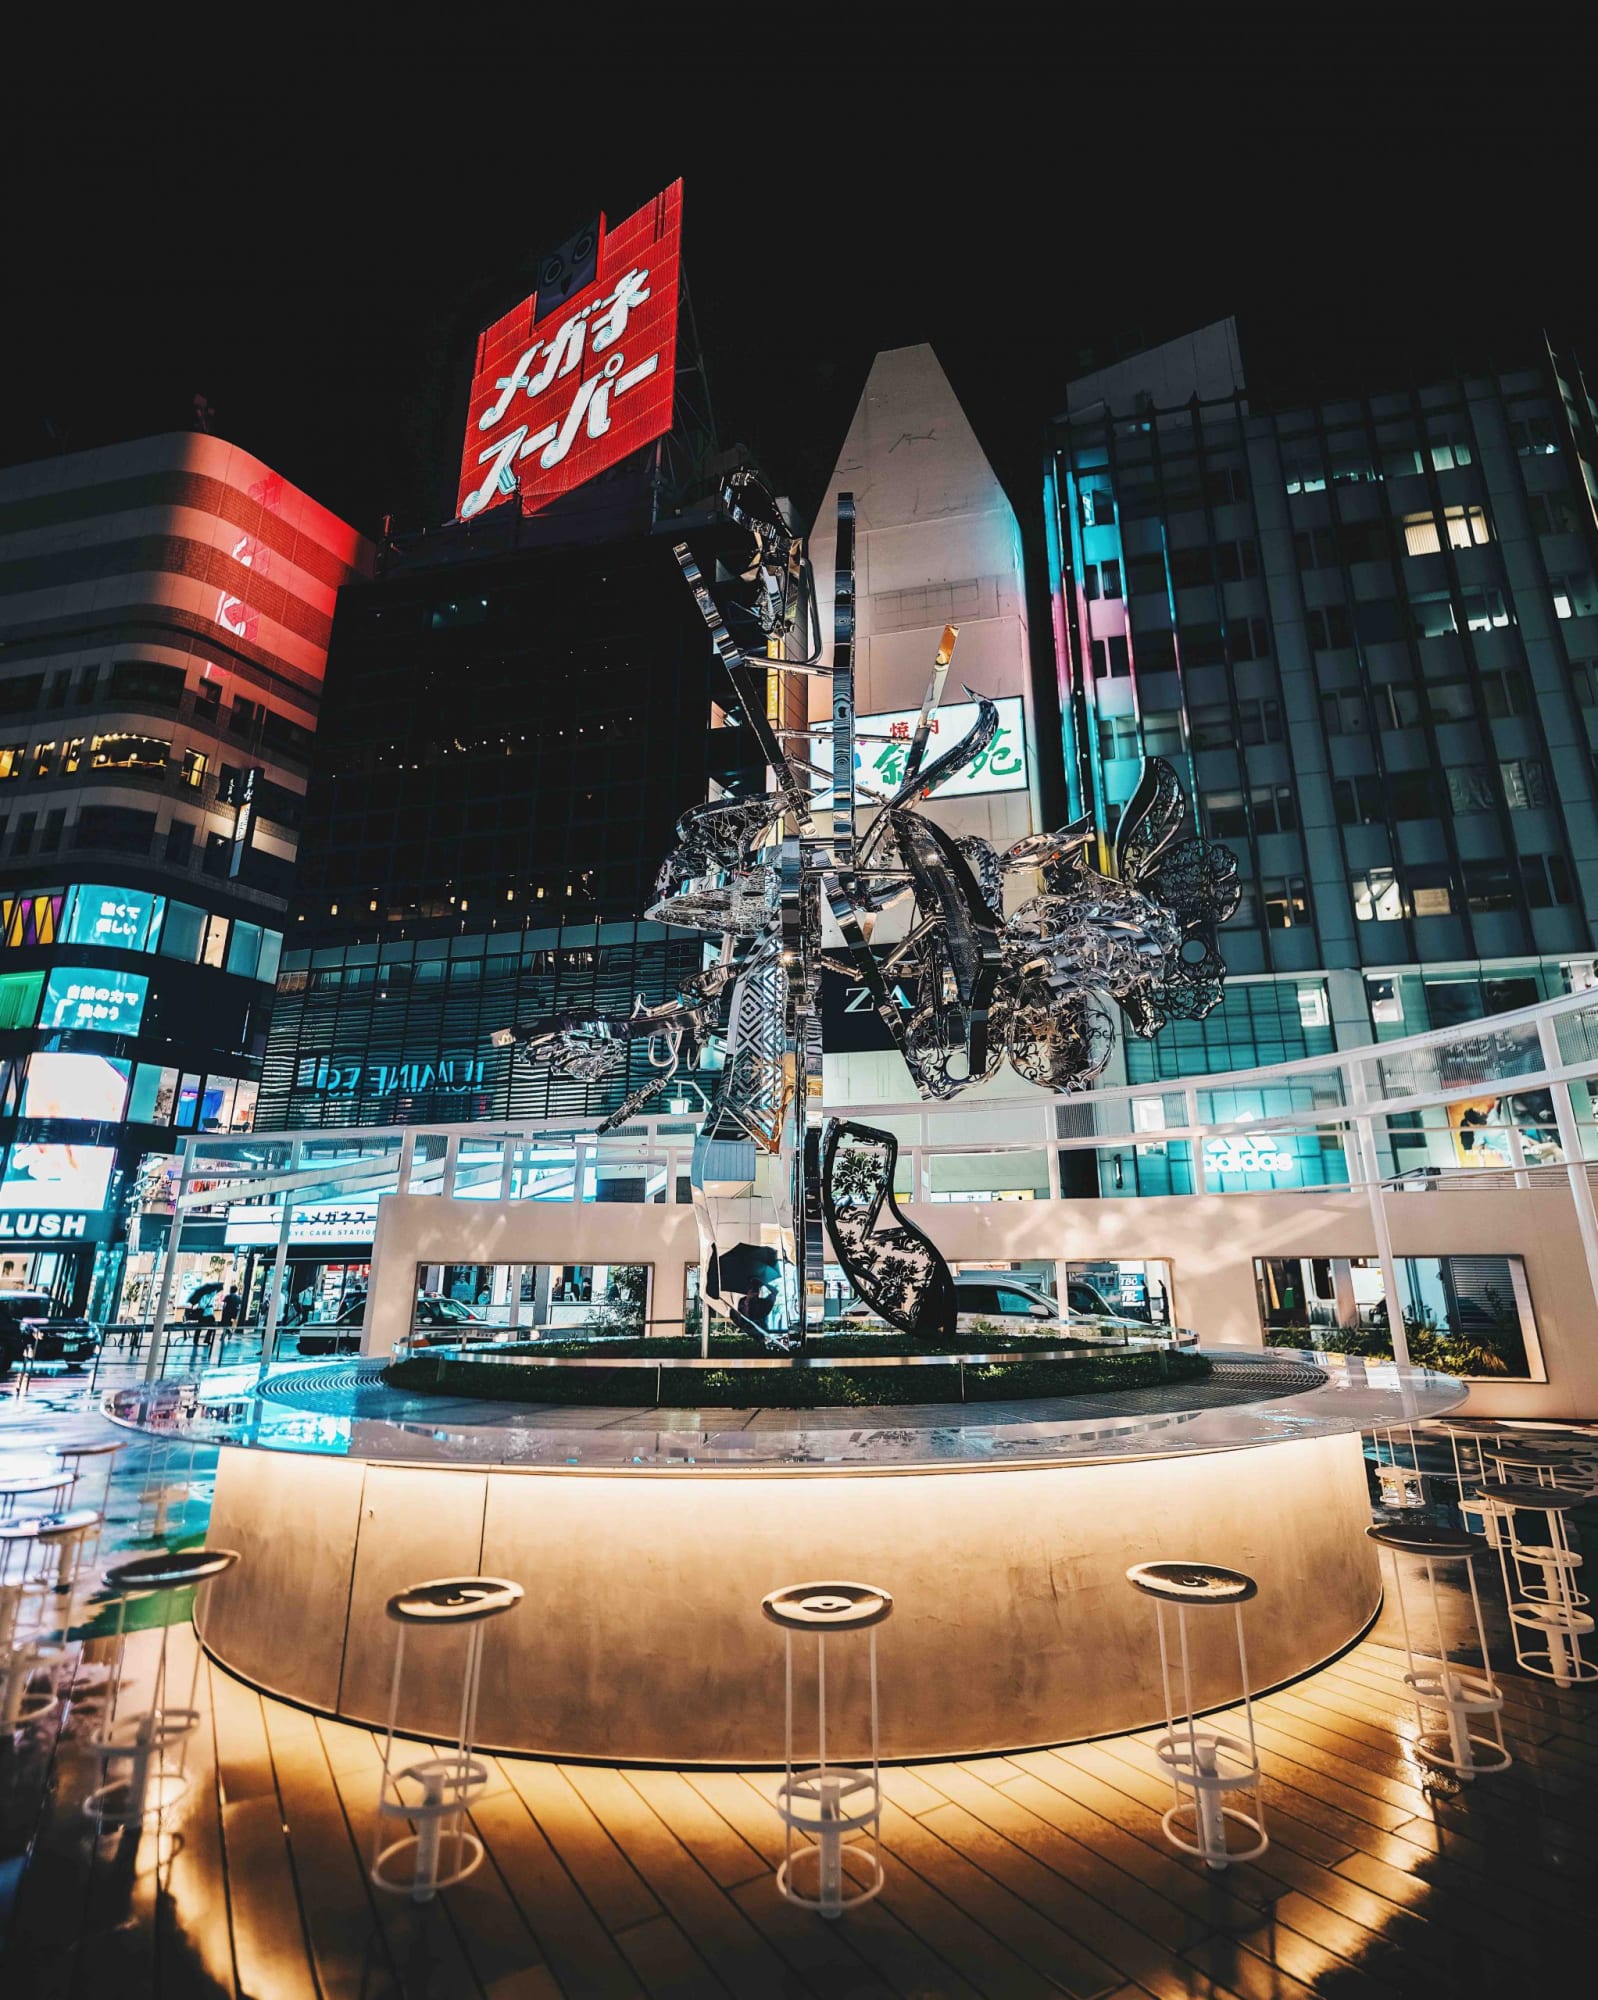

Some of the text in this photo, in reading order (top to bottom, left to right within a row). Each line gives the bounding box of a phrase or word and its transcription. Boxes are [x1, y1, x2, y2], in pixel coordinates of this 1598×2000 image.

[478, 267, 651, 431] メガネ
[460, 352, 659, 519] スーパー
[872, 727, 1023, 786] 叙苑
[1203, 1149, 1294, 1173] adidas
[0, 1213, 87, 1238] LUSH
[310, 1229, 333, 1237] CARE
